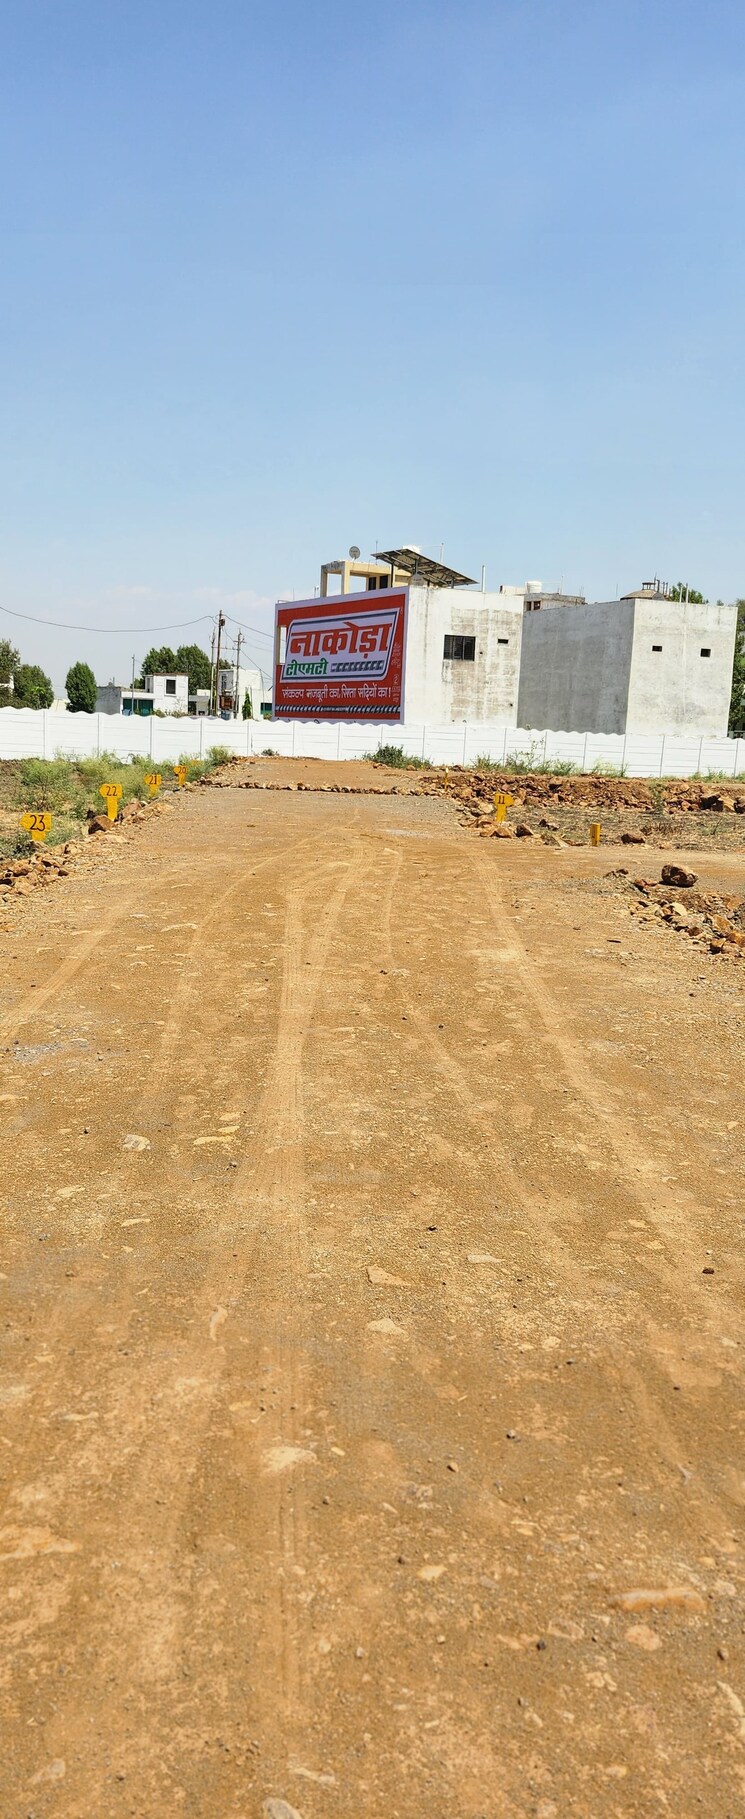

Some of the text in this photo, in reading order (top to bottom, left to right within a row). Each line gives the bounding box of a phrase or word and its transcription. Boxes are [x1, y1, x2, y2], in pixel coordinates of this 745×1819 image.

[289, 621, 393, 659] नाकोड़ा
[285, 657, 329, 676] टीएमटी
[178, 766, 187, 774] 20
[149, 775, 157, 785] 21
[106, 786, 118, 797] 22
[498, 796, 505, 804] 11
[30, 815, 46, 832] 23
